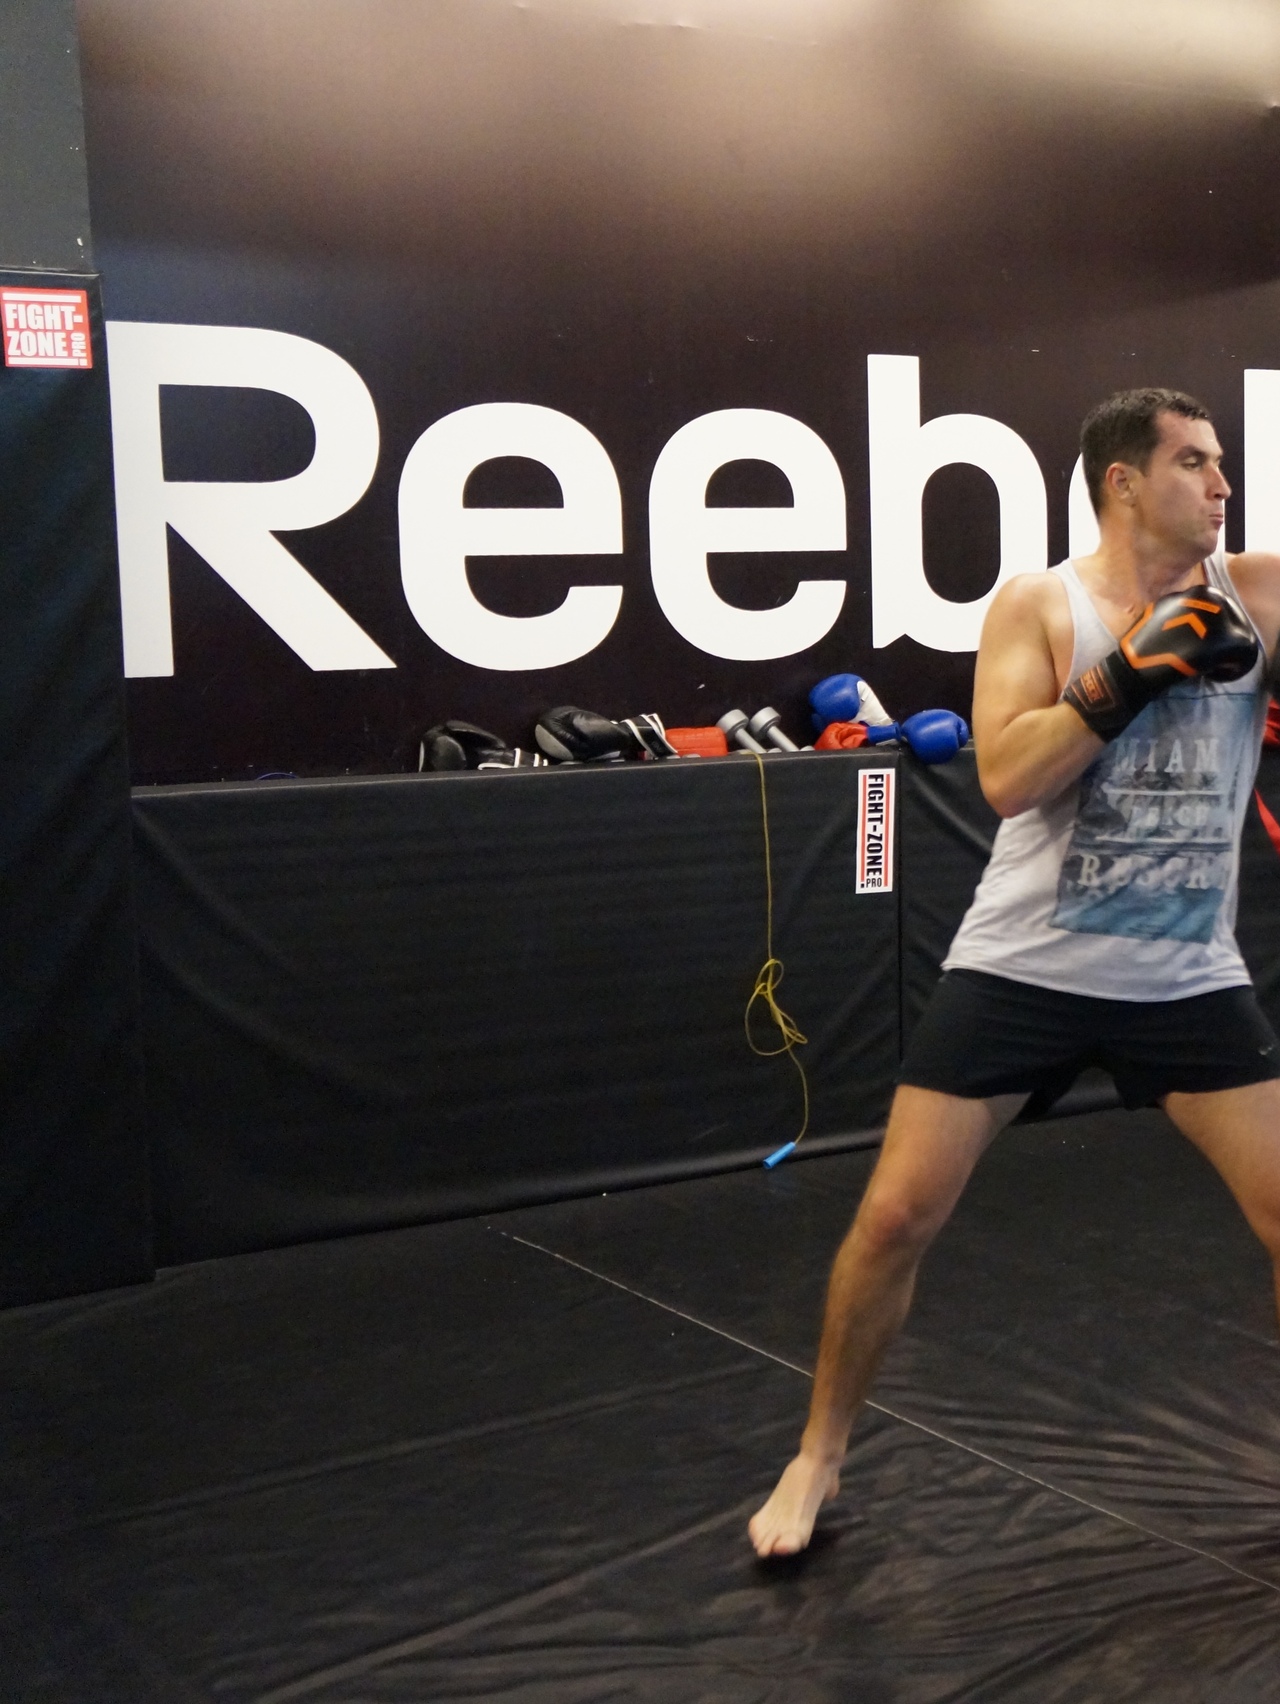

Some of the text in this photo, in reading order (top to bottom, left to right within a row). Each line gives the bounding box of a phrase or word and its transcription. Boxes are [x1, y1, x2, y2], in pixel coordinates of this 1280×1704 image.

[4, 303, 84, 331] FIGHT-
[6, 330, 69, 357] ZONE
[866, 774, 885, 877] FIGHT-ZONE
